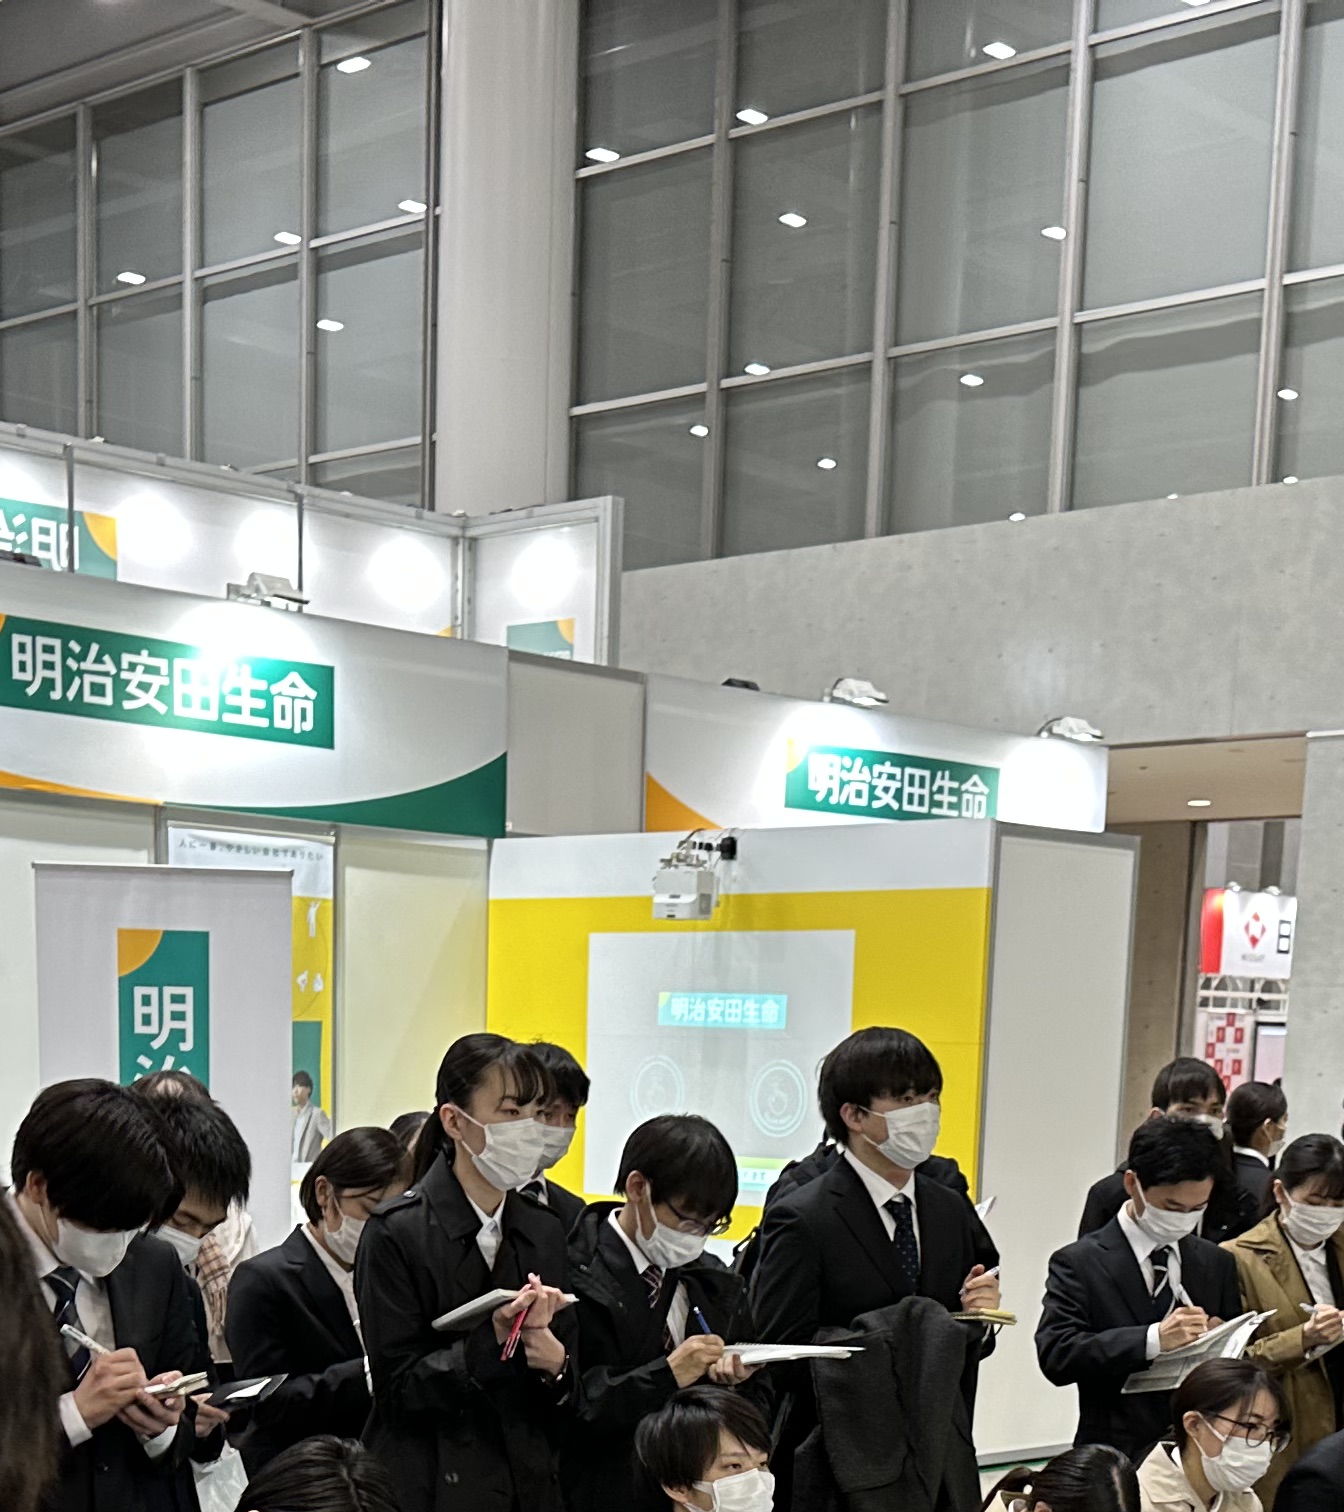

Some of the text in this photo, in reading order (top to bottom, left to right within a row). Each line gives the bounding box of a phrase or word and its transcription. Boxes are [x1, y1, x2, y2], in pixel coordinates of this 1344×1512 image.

[11, 632, 317, 734] 明治安田生命
[808, 752, 989, 820] 明治安田生命
[670, 997, 779, 1024] 明治安田生命
